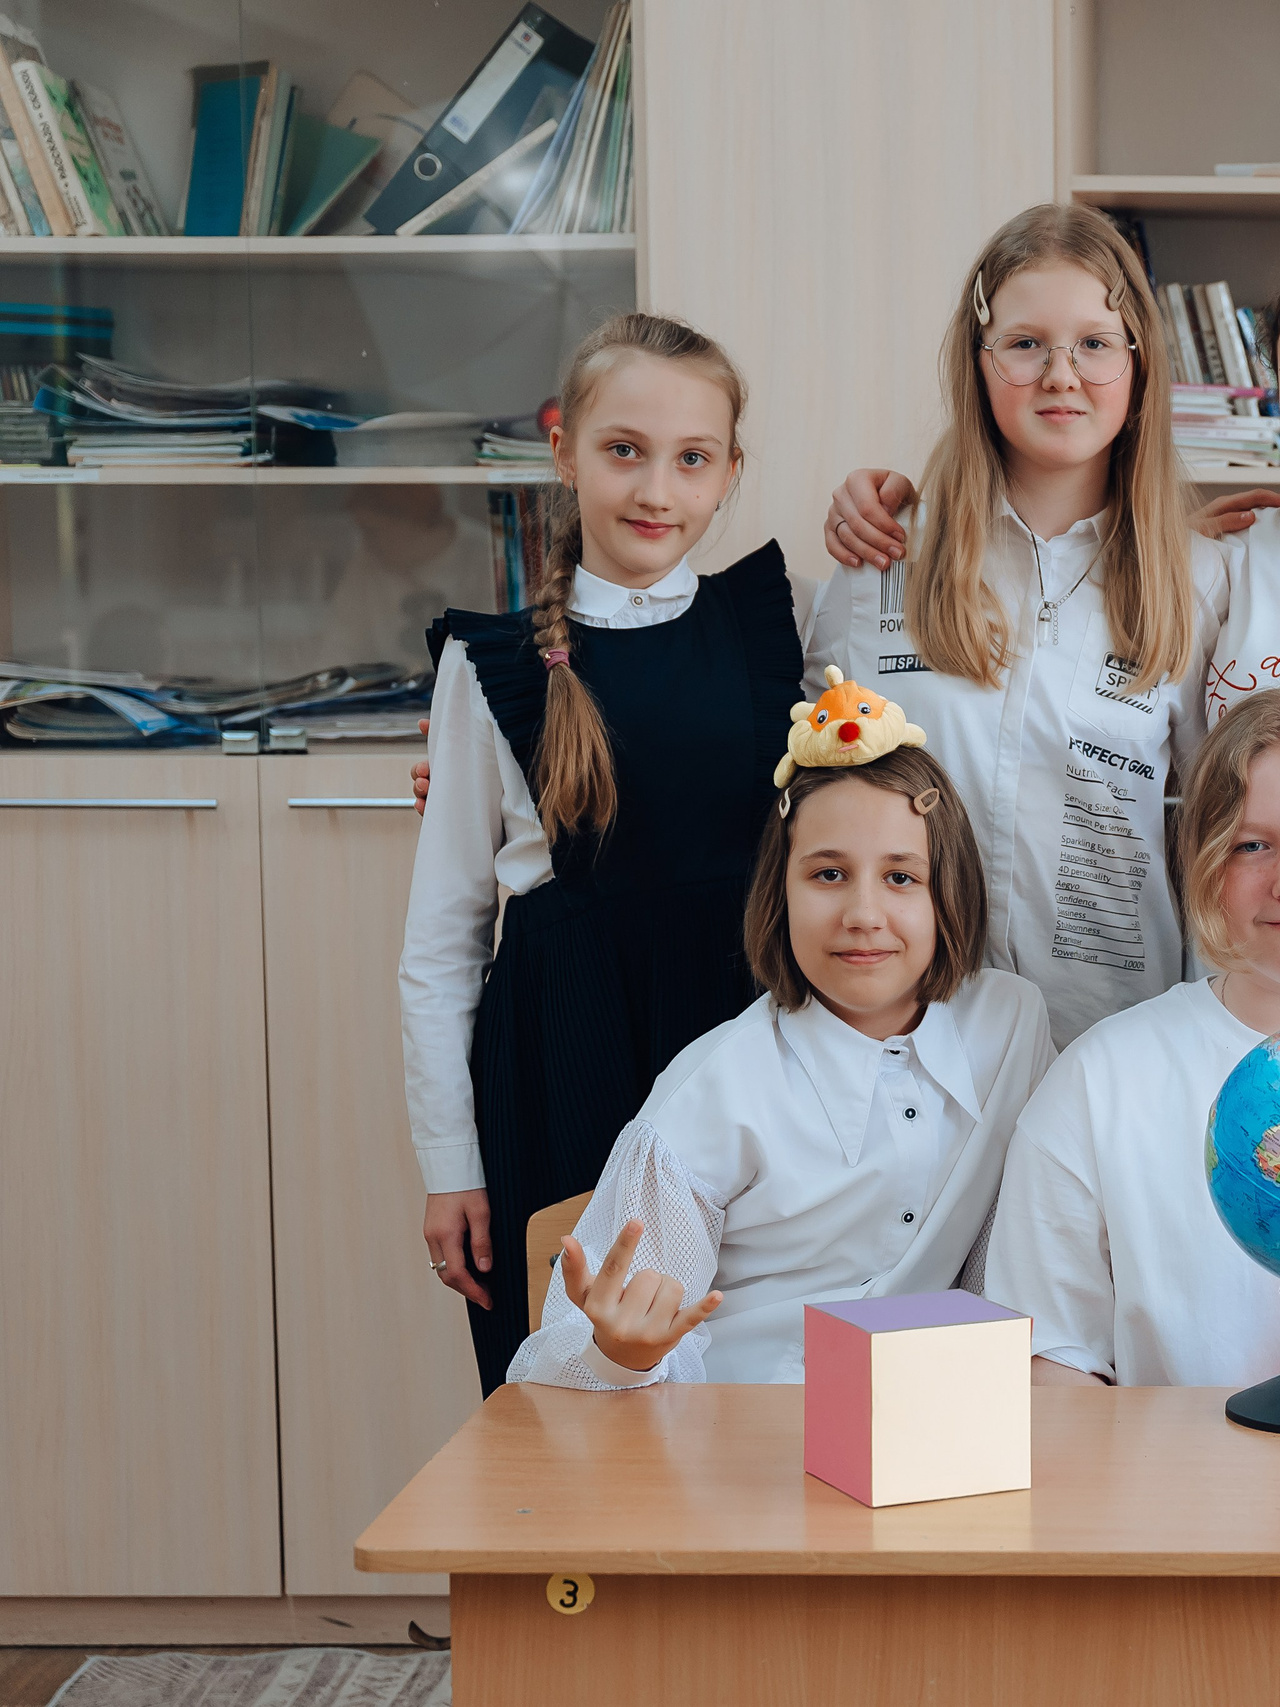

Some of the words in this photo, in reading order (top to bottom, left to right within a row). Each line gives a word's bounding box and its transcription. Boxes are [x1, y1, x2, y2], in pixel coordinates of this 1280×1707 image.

[880, 618, 905, 633] POW
[1068, 736, 1130, 771] PERFECT
[1128, 760, 1155, 780] GIRL
[1064, 793, 1093, 812] Serving
[1062, 812, 1093, 827] Amount
[1094, 822, 1107, 831] Per
[1061, 835, 1096, 851] Sparkling
[1097, 842, 1116, 855] Eyes
[1060, 850, 1098, 866] Happiness
[1128, 865, 1148, 876] 100%
[1058, 866, 1070, 874] 4D
[1070, 867, 1112, 883] personality
[1055, 879, 1081, 891] Aegyo
[1054, 893, 1098, 908] Confidence
[1122, 959, 1146, 970] 1000%
[559, 1578, 580, 1609] 3
